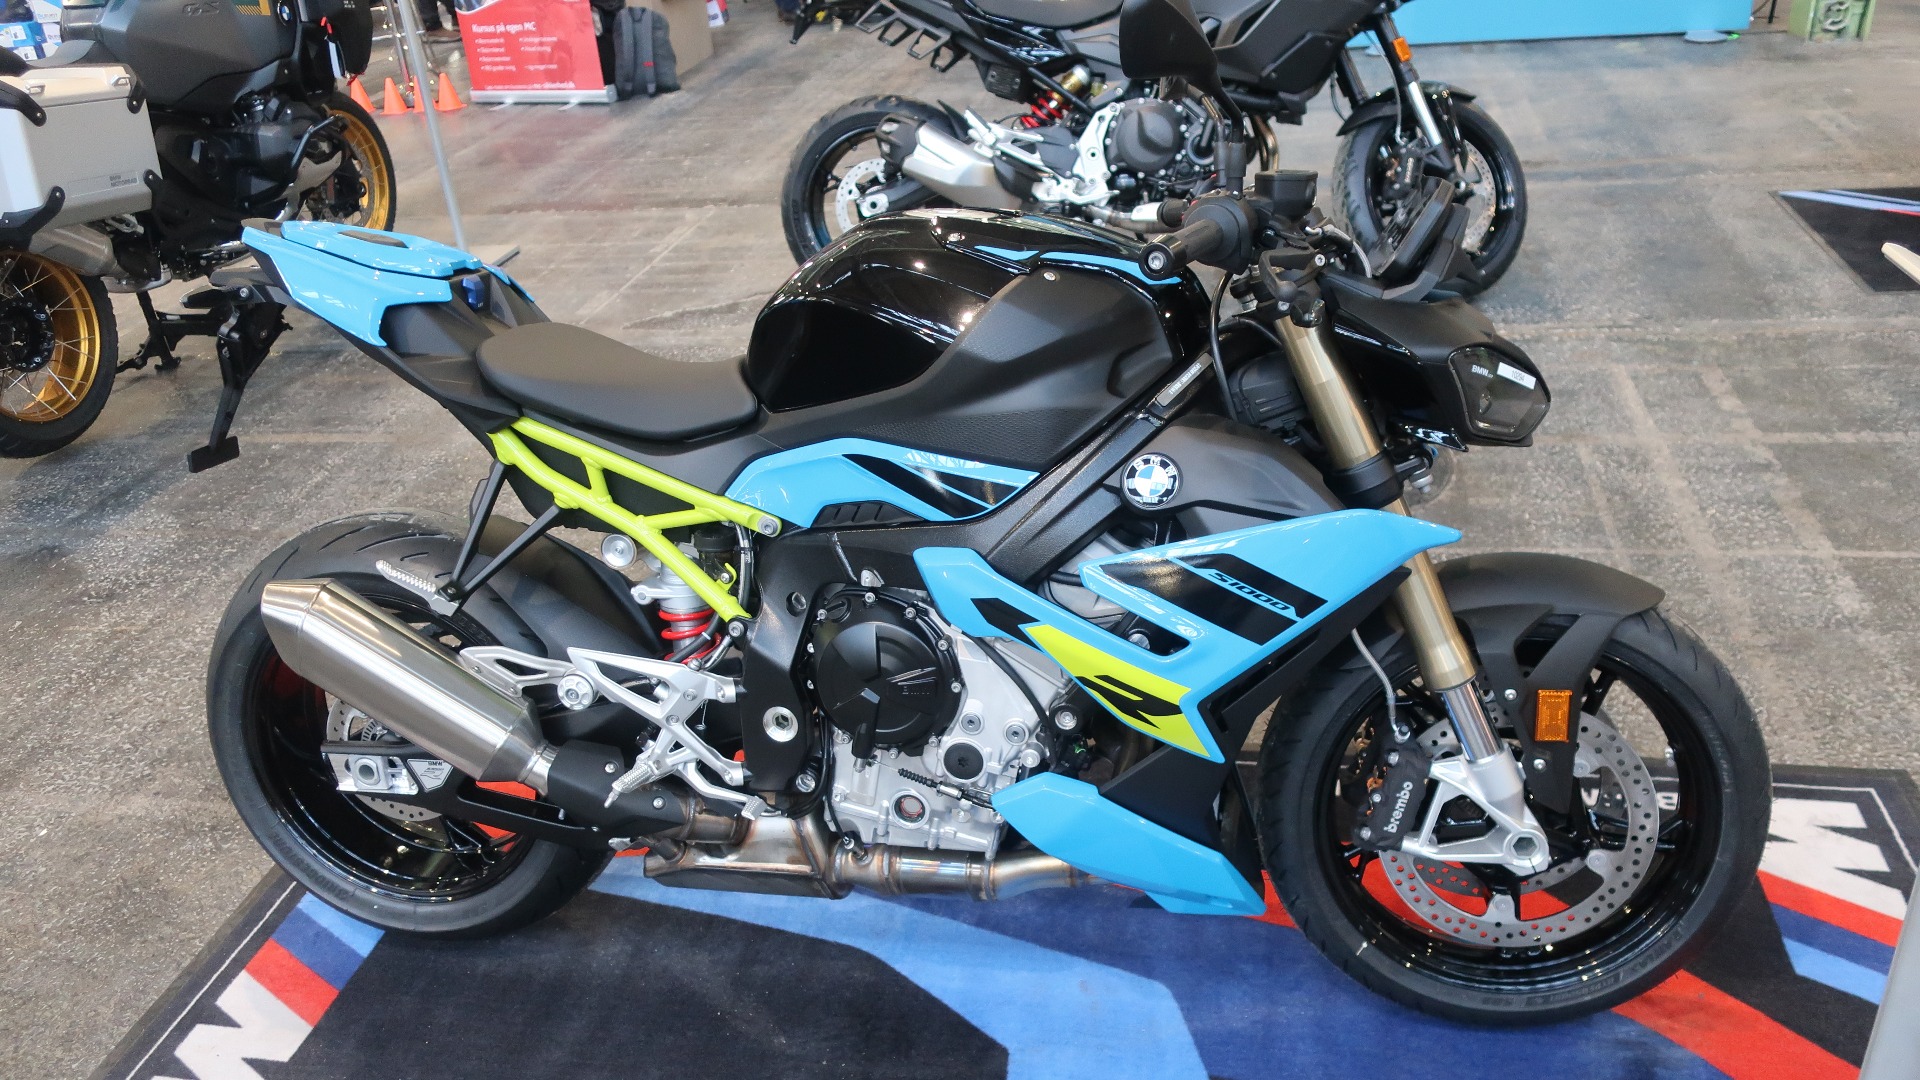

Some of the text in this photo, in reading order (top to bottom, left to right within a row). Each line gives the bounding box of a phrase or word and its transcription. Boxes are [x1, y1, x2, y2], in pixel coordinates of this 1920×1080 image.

[471, 22, 536, 34] Kursus på egen MC
[1471, 364, 1489, 377] BMW
[1208, 572, 1291, 611] S1000
[1383, 781, 1414, 833] brembo
